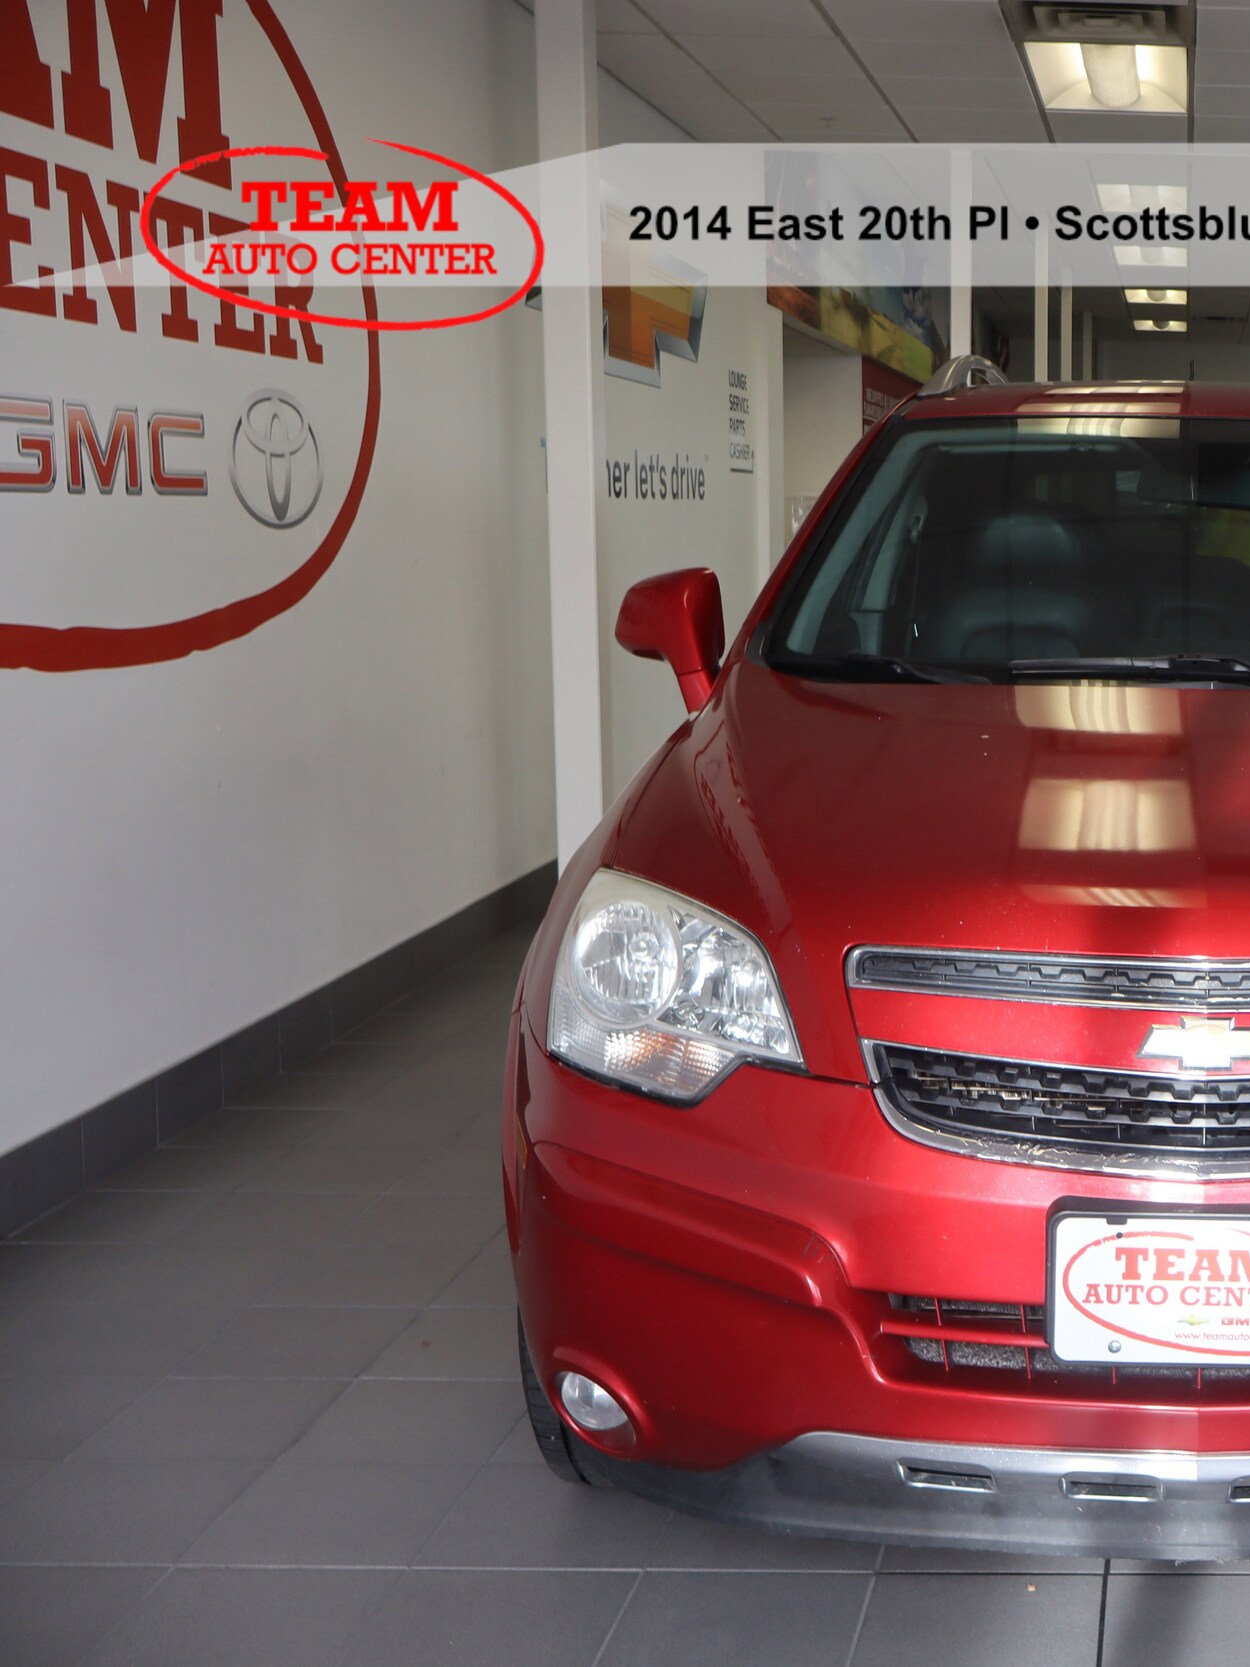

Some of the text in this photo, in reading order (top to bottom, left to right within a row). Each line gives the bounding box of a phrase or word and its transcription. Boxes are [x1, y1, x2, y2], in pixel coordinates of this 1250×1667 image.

[728, 369, 748, 391] LOUNGE
[729, 394, 750, 415] SERVICE
[729, 418, 746, 436] PARTS
[0, 393, 208, 496] GMC
[730, 442, 751, 461] CASHIER
[634, 449, 667, 499] let's
[671, 453, 705, 500] drive
[1082, 1283, 1169, 1306] AUTO
